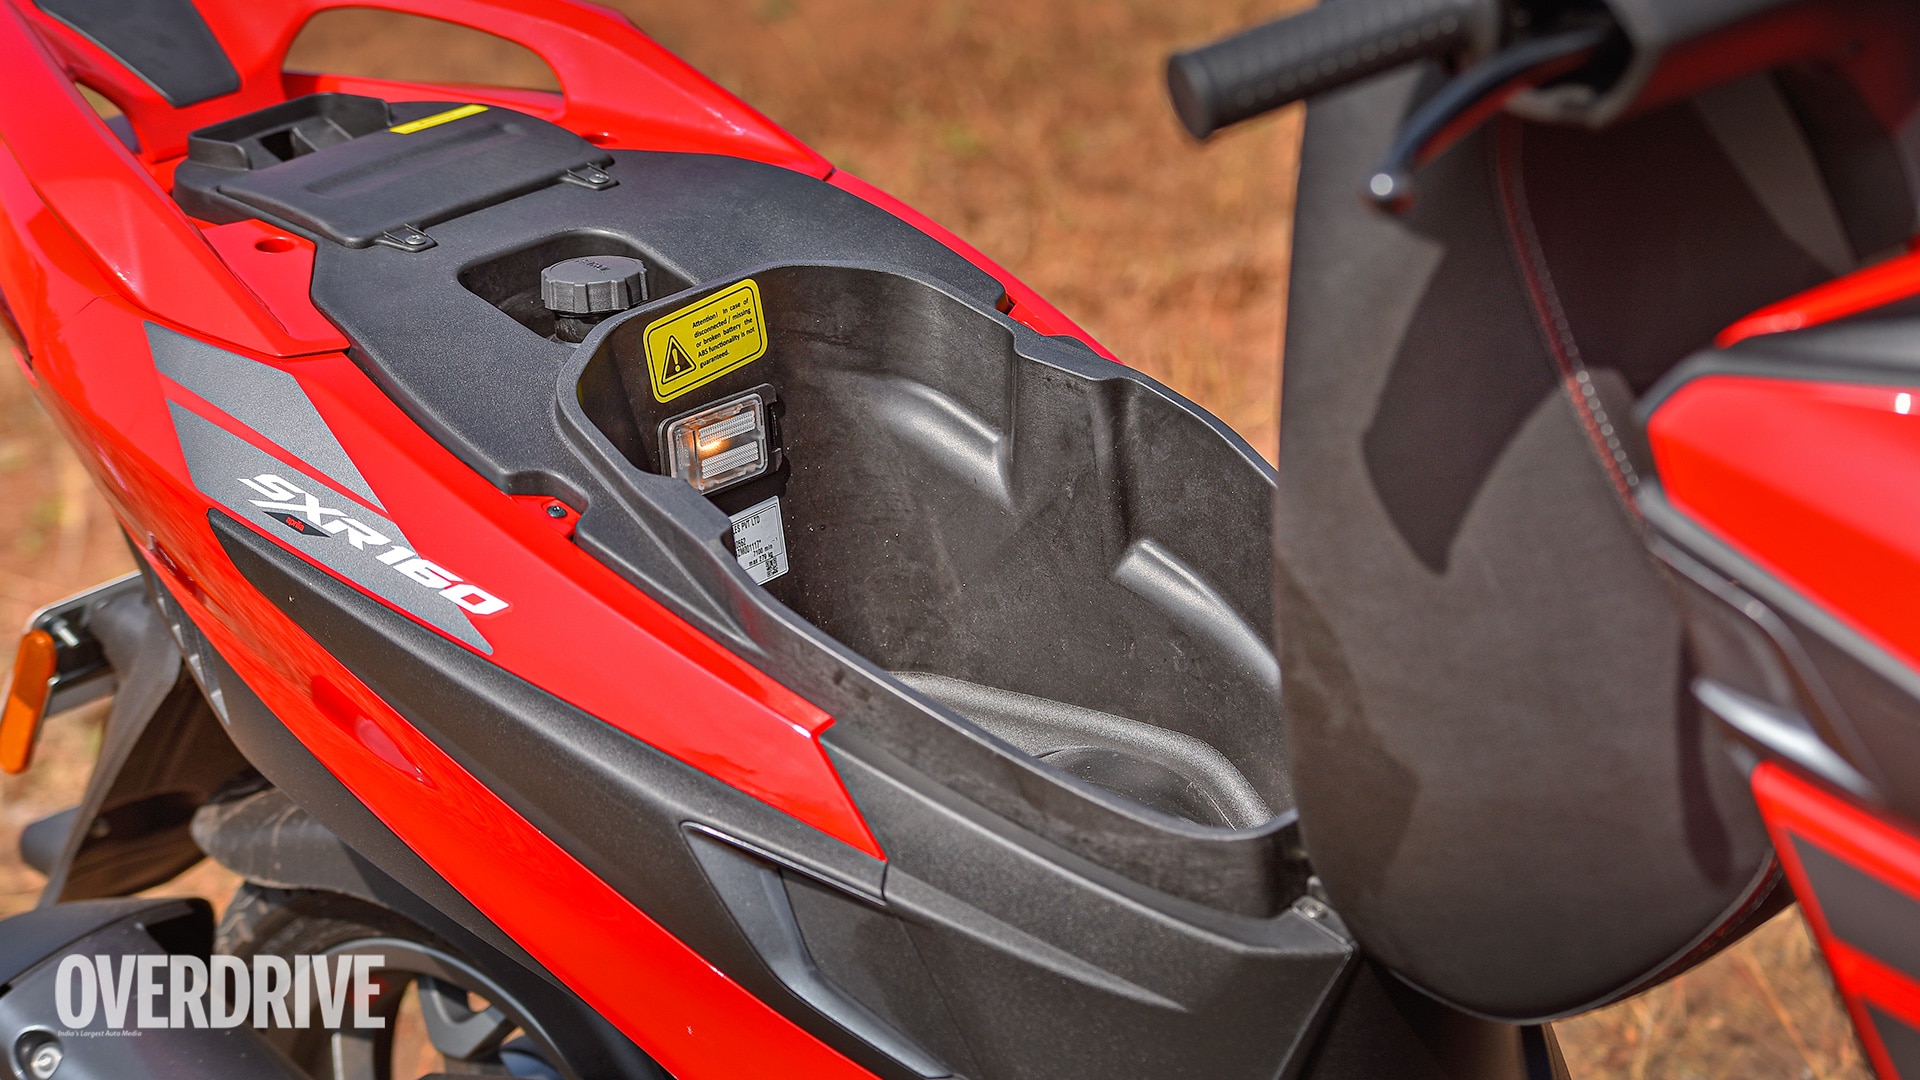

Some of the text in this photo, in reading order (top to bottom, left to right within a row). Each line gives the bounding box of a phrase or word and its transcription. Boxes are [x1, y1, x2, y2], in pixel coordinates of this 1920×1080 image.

[729, 303, 741, 311] case
[743, 297, 749, 305] of
[694, 318, 727, 338] disconnected
[732, 308, 751, 320] missing
[703, 333, 721, 344] broken
[723, 323, 741, 335] battery
[698, 348, 709, 358] ABS
[708, 335, 740, 353] functionality
[746, 326, 755, 335] not
[285, 516, 305, 532] aprilia
[741, 519, 750, 531] PVT
[751, 515, 760, 527] LTD
[749, 558, 758, 566] max
